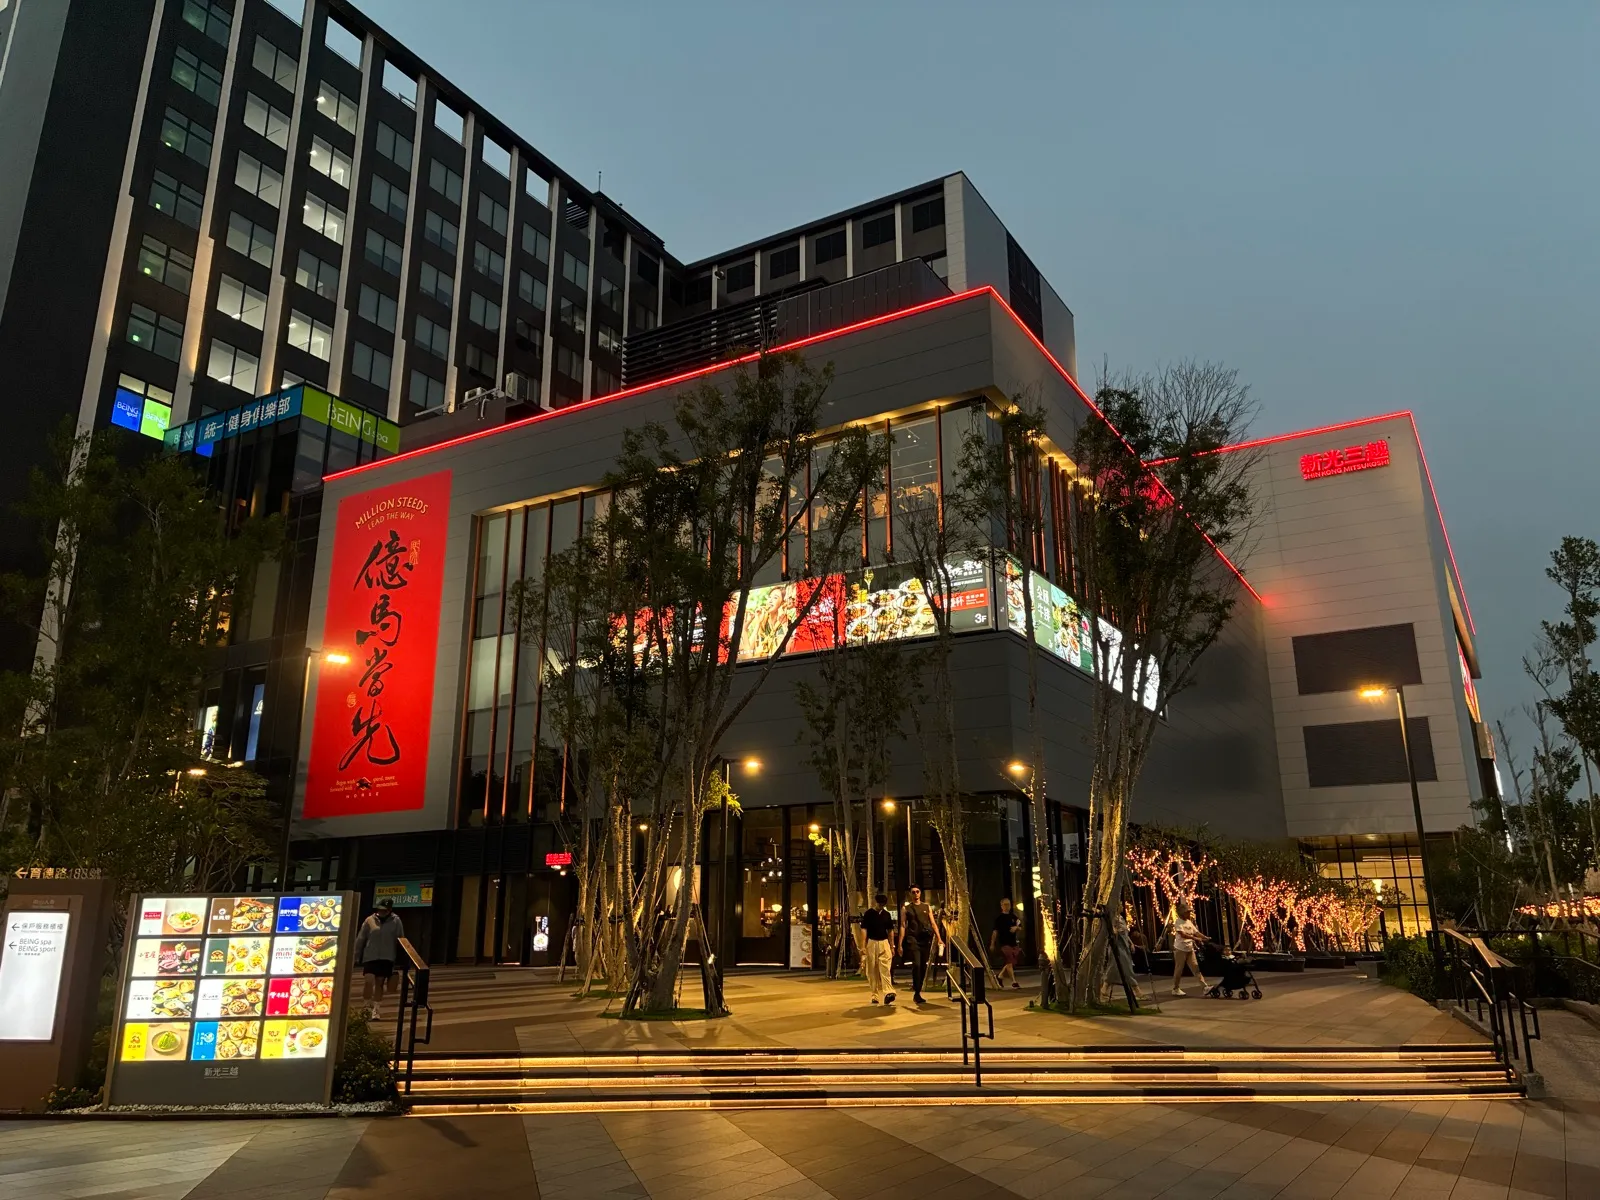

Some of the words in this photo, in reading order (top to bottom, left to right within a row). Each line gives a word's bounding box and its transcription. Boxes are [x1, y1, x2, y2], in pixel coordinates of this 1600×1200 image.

[117, 401, 139, 415] BEING
[203, 396, 291, 440] 統一健身俱樂部
[327, 403, 372, 436] BEING
[371, 431, 389, 444] spa
[1300, 439, 1390, 473] 新光三越
[1303, 472, 1321, 480] SHIN
[1322, 467, 1342, 477] KONG
[1343, 459, 1390, 473] MITSUKOSHI
[355, 498, 395, 530] MILLION
[396, 496, 429, 514] STEEDS
[367, 515, 385, 531] LEAD
[386, 511, 399, 520] THE
[400, 511, 415, 521] WAY
[974, 612, 987, 624] 3F
[337, 529, 414, 772] 億馬當先
[40, 939, 52, 947] spa
[203, 1066, 239, 1077] 新光三越
